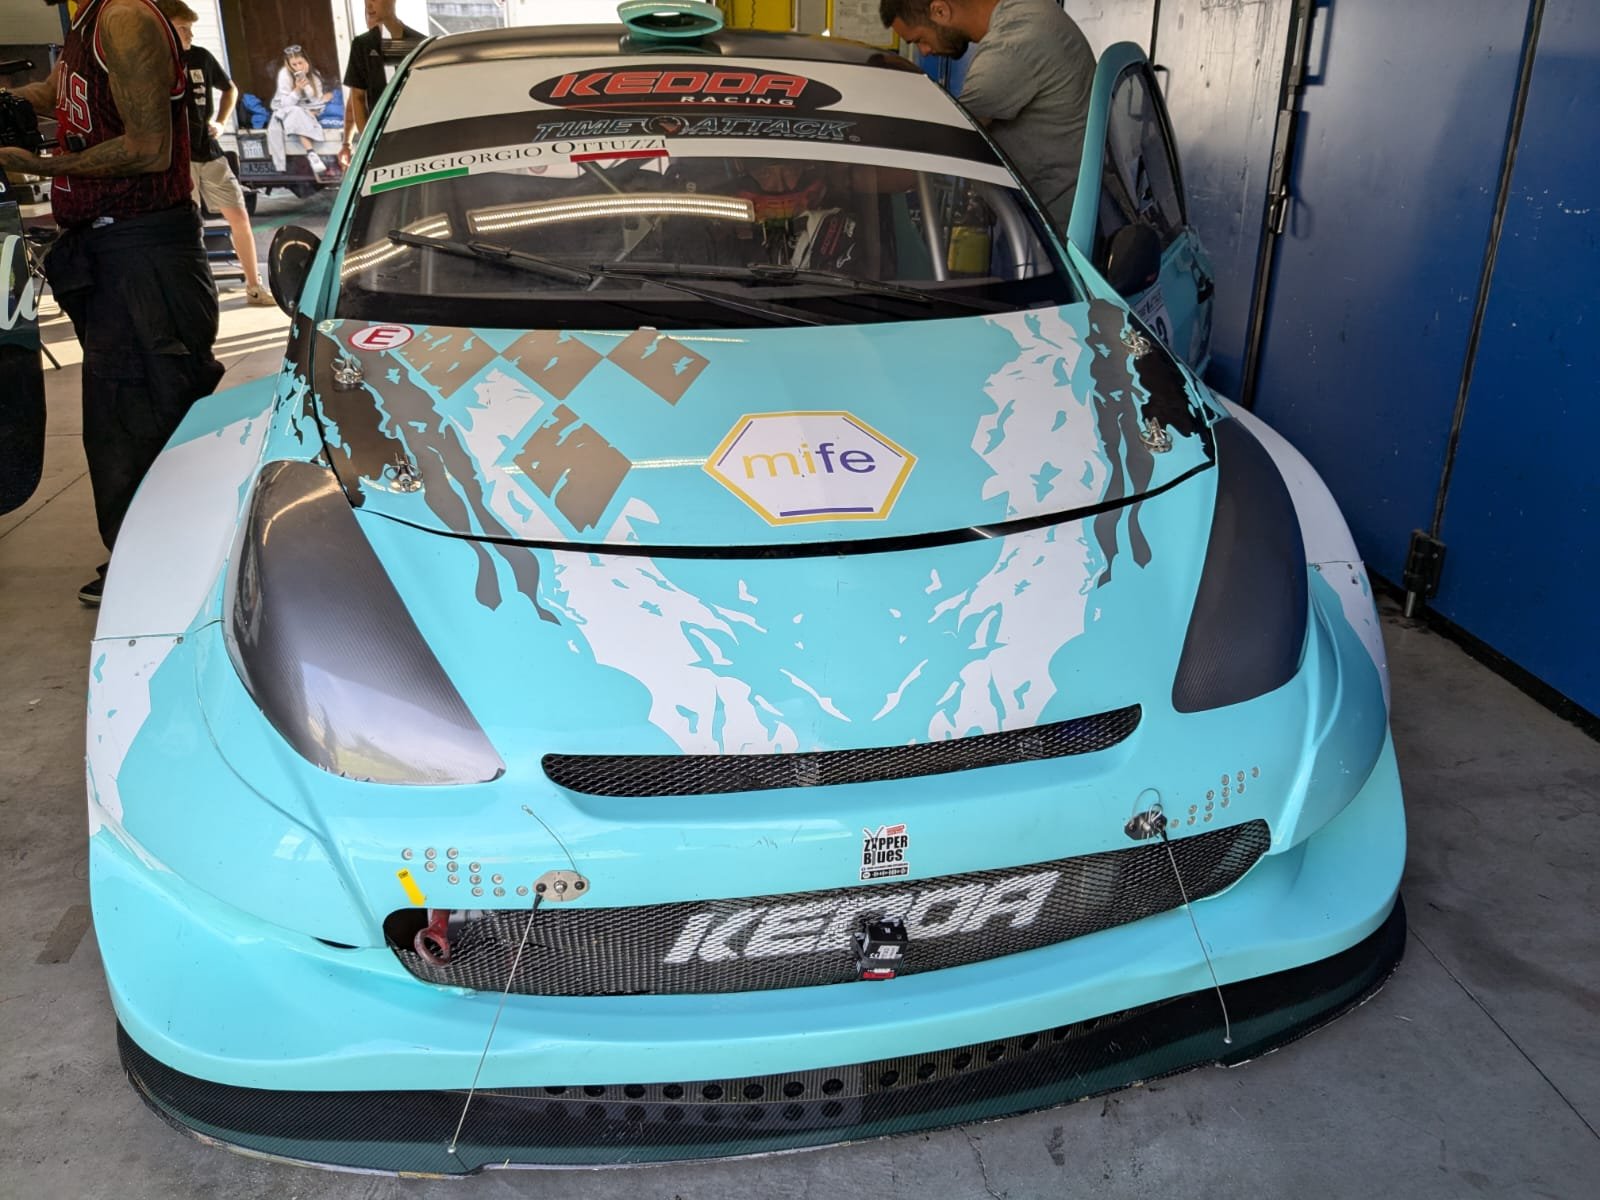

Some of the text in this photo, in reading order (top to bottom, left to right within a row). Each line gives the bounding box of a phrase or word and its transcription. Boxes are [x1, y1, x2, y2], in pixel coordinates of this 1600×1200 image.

[550, 71, 808, 98] KEDDA
[681, 95, 795, 106] RACING
[532, 117, 647, 142] TIME
[689, 116, 856, 139] ATTACK
[373, 138, 666, 183] PIERGIORGIO OTTUZZI
[363, 328, 401, 345] E
[742, 443, 876, 480] mife
